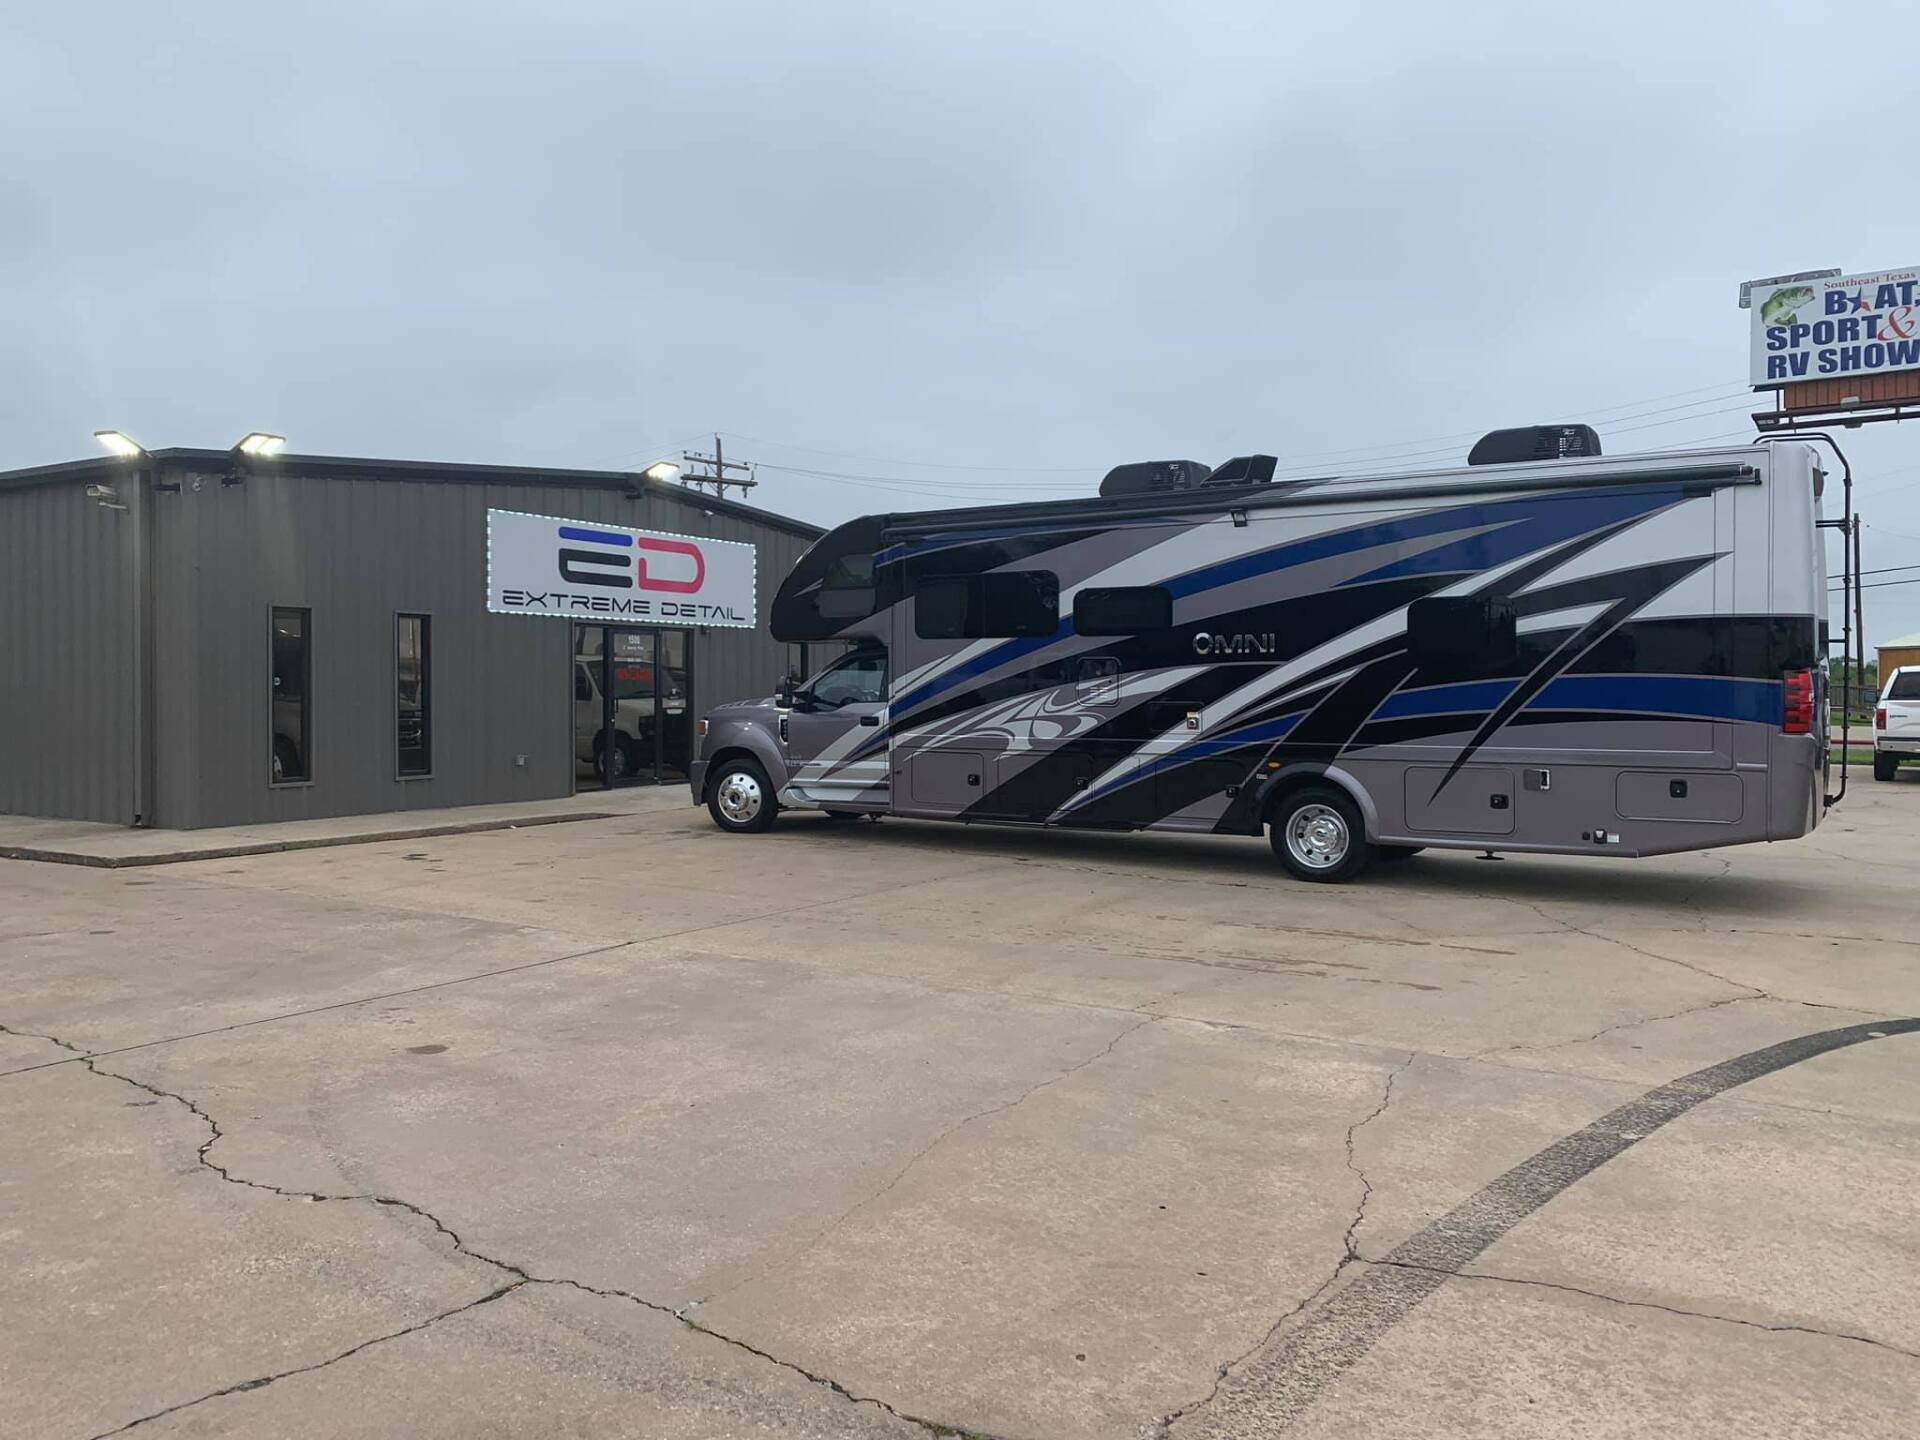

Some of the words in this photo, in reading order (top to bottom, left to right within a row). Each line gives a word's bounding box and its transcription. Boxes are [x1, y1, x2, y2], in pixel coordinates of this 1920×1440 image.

[1824, 276, 1880, 289] Southeast
[1884, 272, 1916, 282] Texas
[1766, 314, 1883, 351] SPORT
[1767, 351, 1811, 380] RV
[1818, 339, 1920, 374] SHOW
[558, 526, 705, 594] ED
[502, 589, 651, 615] EXTREME
[661, 602, 745, 621] DETAIL
[1192, 632, 1275, 655] OMNI
